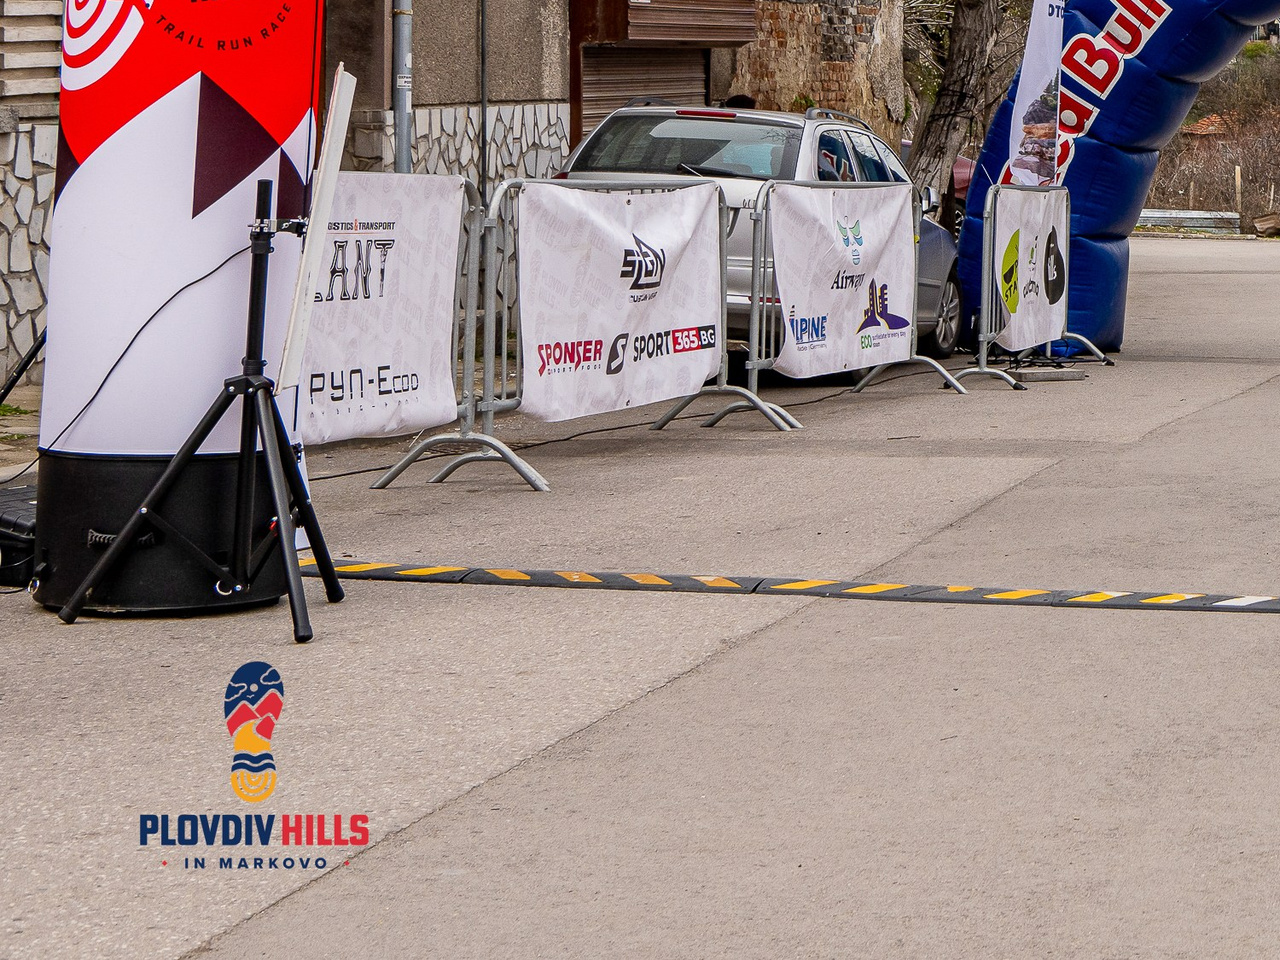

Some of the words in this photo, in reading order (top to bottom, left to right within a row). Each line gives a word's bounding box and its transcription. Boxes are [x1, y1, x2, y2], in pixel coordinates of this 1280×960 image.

[156, 14, 204, 49] TRAIL
[217, 36, 253, 50] RUN
[260, 2, 291, 39] RACE
[359, 221, 395, 230] TRANSPORT
[537, 339, 603, 377] SPONSER
